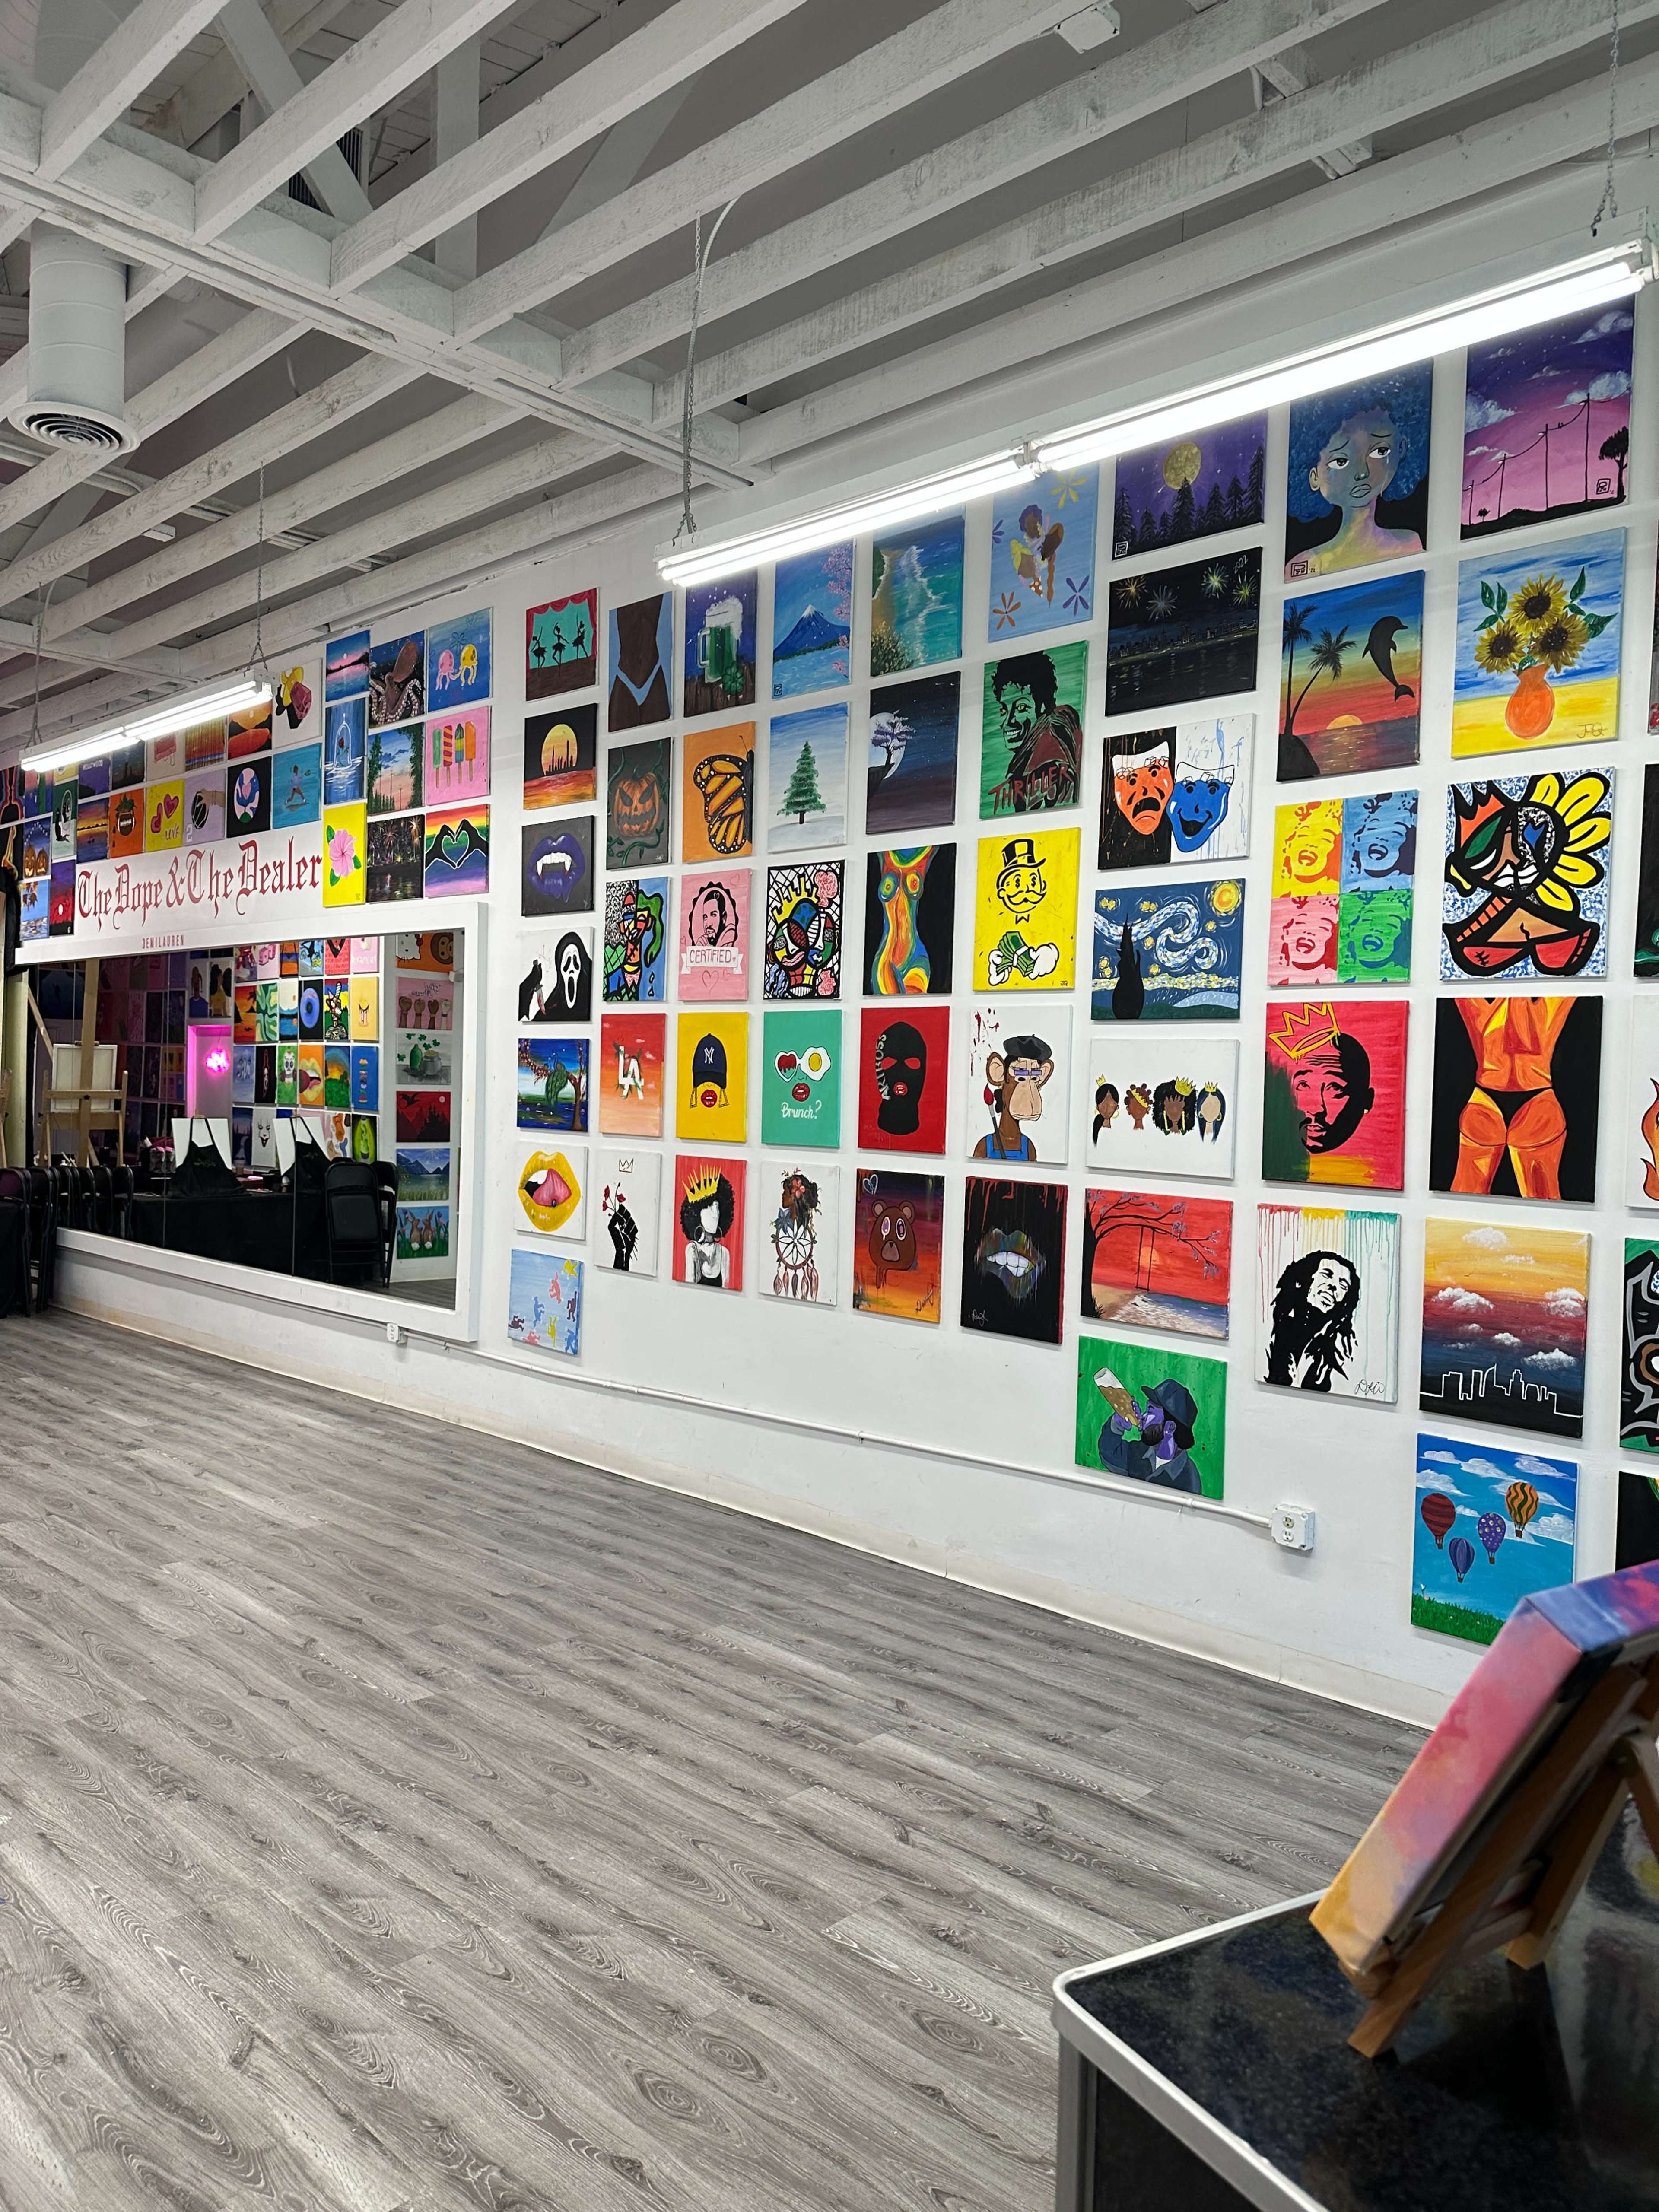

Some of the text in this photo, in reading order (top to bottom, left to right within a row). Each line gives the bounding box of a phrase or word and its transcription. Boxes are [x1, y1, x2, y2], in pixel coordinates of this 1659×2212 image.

[988, 763, 1074, 815] THRILLER
[77, 836, 323, 932] The Dope & The Dealer
[690, 949, 731, 963] CERTIFIED
[704, 1046, 715, 1064] NY
[618, 1046, 645, 1100] LA
[781, 1100, 822, 1119] Brunch?
